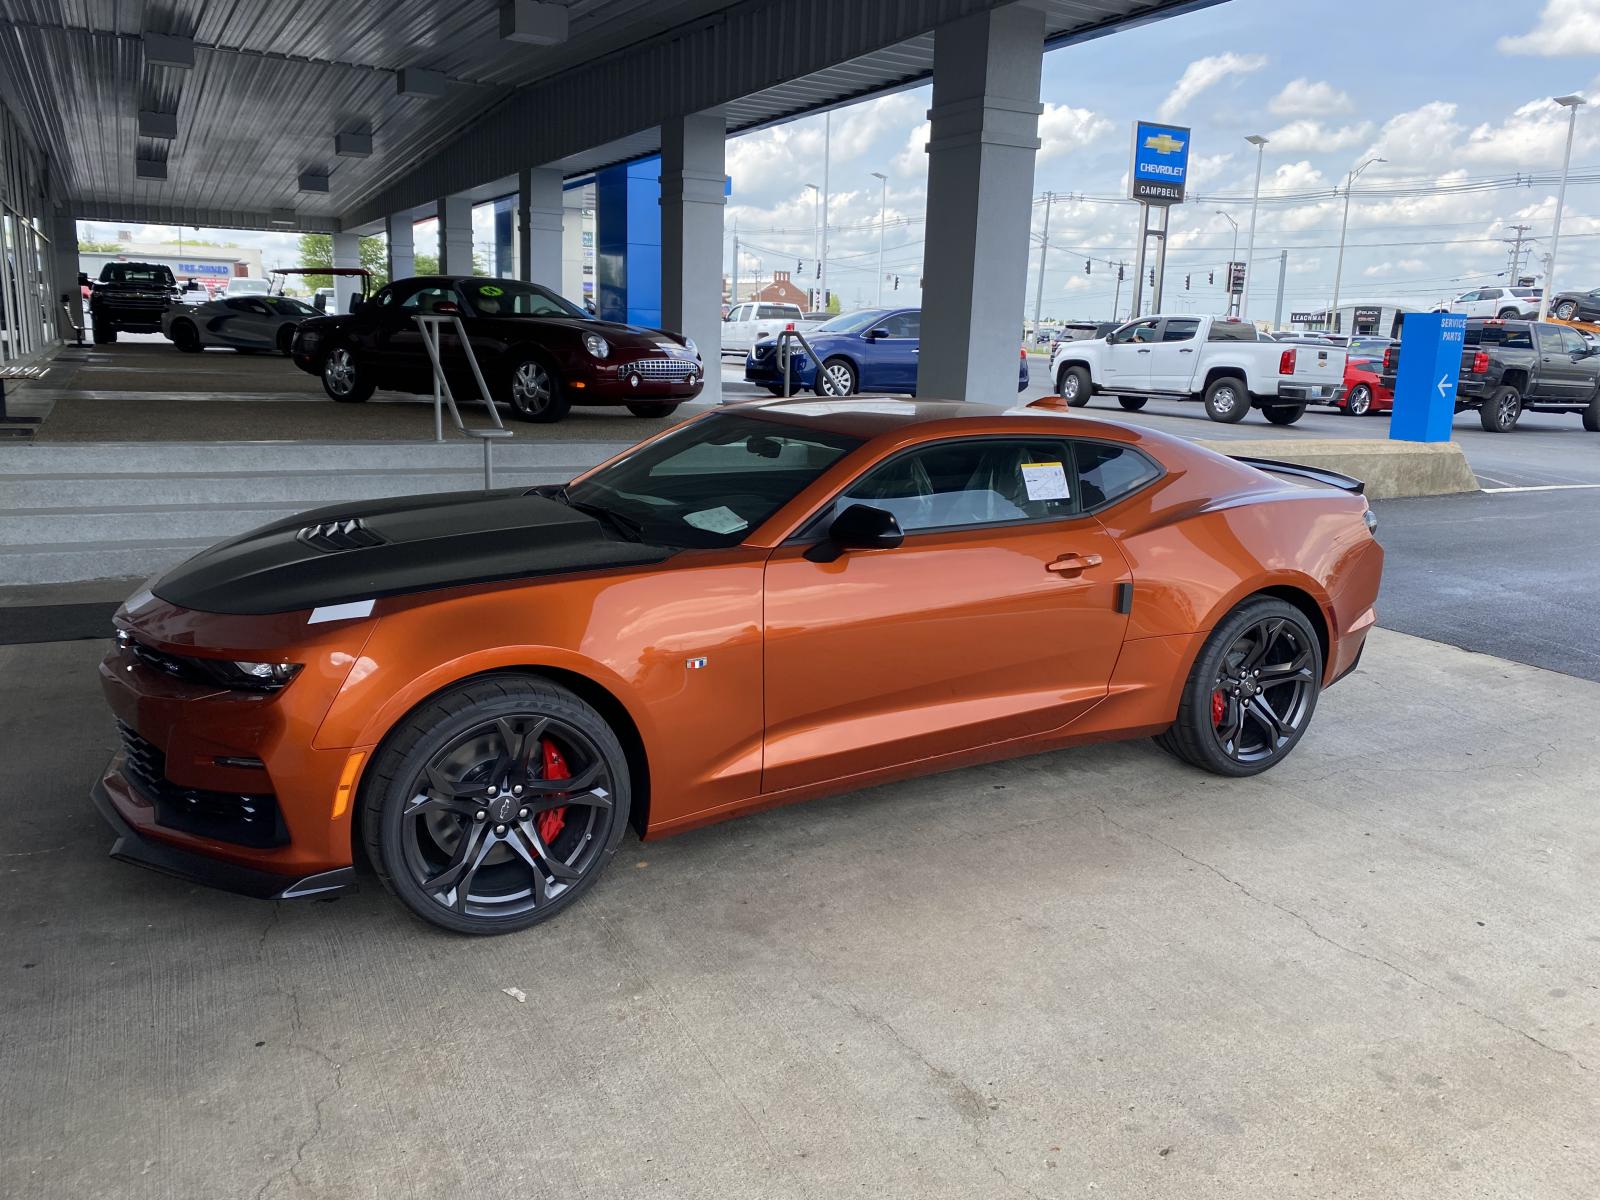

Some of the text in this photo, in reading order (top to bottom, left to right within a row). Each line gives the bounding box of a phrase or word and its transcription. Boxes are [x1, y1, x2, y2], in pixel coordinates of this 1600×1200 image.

[1140, 163, 1184, 176] CHEVROLET
[1140, 185, 1179, 198] CAMPBELL
[178, 264, 229, 274] PRE-OWNED
[1440, 318, 1466, 329] SERVICE
[1442, 331, 1462, 342] PARTS
